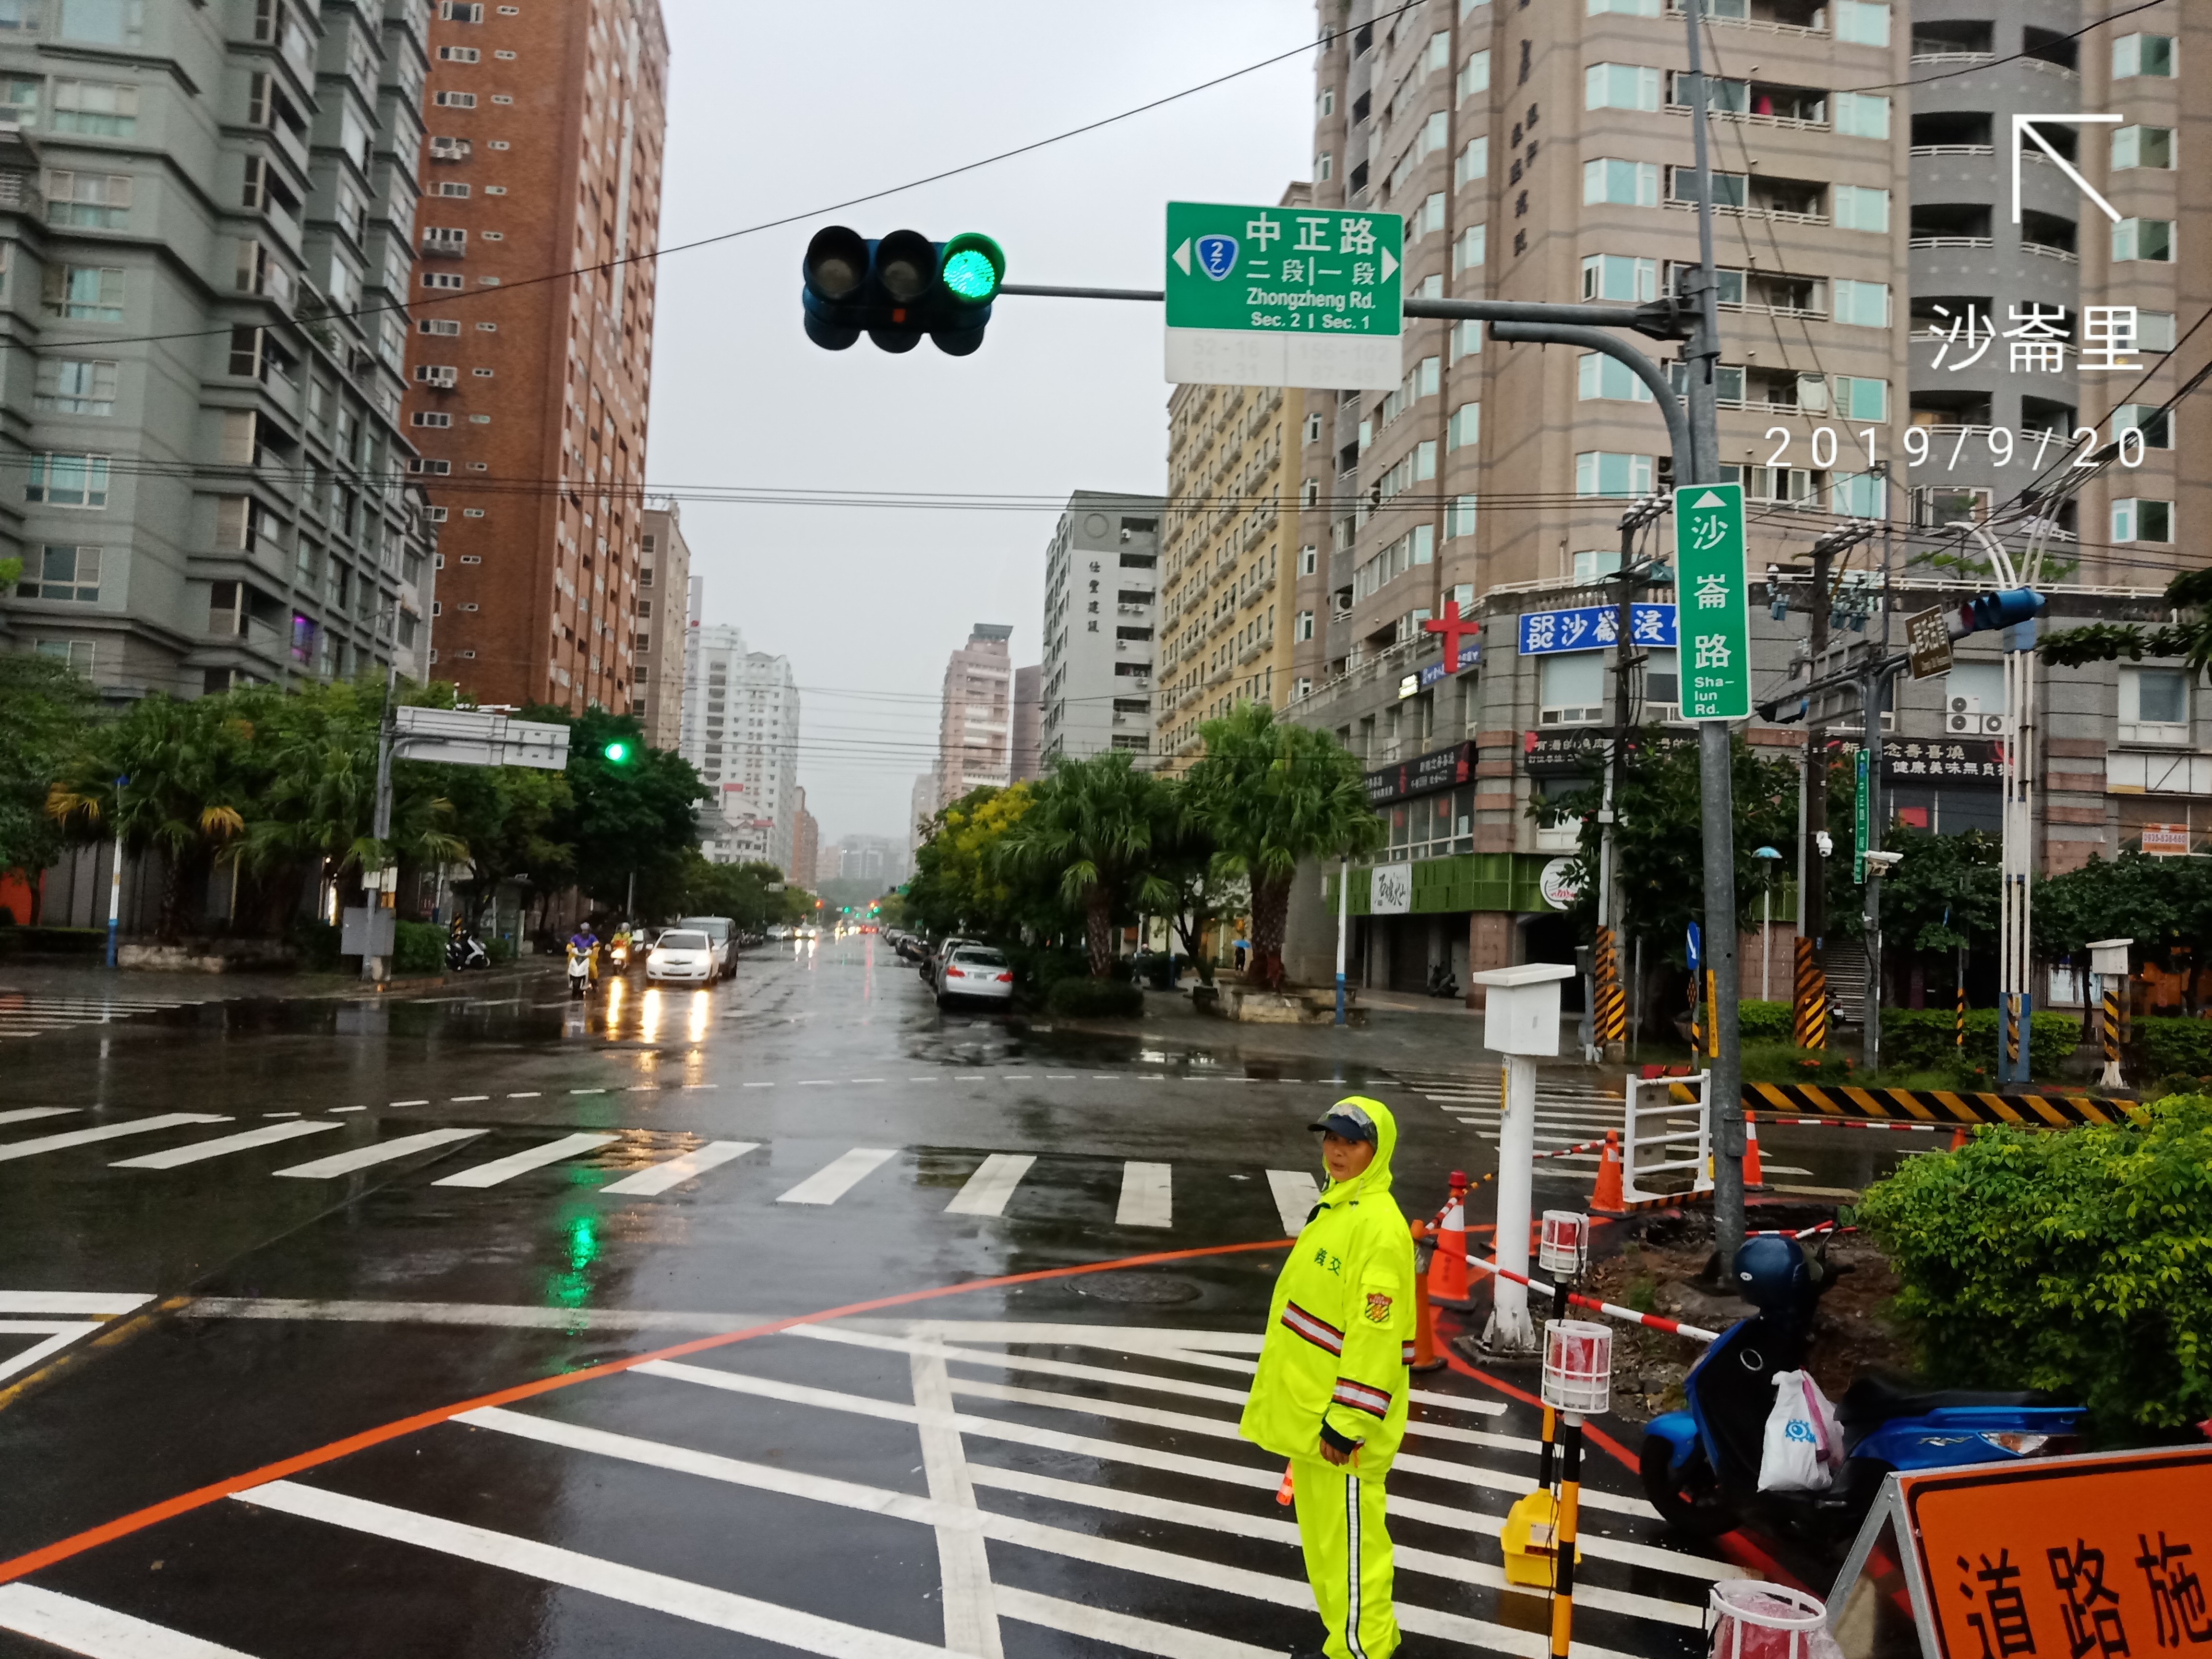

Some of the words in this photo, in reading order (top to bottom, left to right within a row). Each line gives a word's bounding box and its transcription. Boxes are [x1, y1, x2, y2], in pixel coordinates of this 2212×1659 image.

[1246, 212, 1378, 255] 中正路
[1246, 259, 1304, 283] 二段
[1317, 262, 1375, 286] 一段
[1246, 288, 1345, 313] Zhongzheng
[1349, 292, 1376, 309] Rd.
[1250, 312, 1286, 327] Sec.
[1290, 313, 1300, 327] 2
[1322, 314, 1357, 329] Sec.
[1361, 315, 1369, 329] 1
[1692, 515, 1732, 668] 沙崙路
[1529, 615, 1555, 633] SR
[1561, 610, 1680, 647] 沙崙浸
[1527, 632, 1554, 651] BC
[1695, 677, 1735, 688] Sha-
[1695, 691, 1718, 701] lun
[1695, 704, 1719, 715] Rd.
[1956, 1531, 2212, 1659] 道路施
